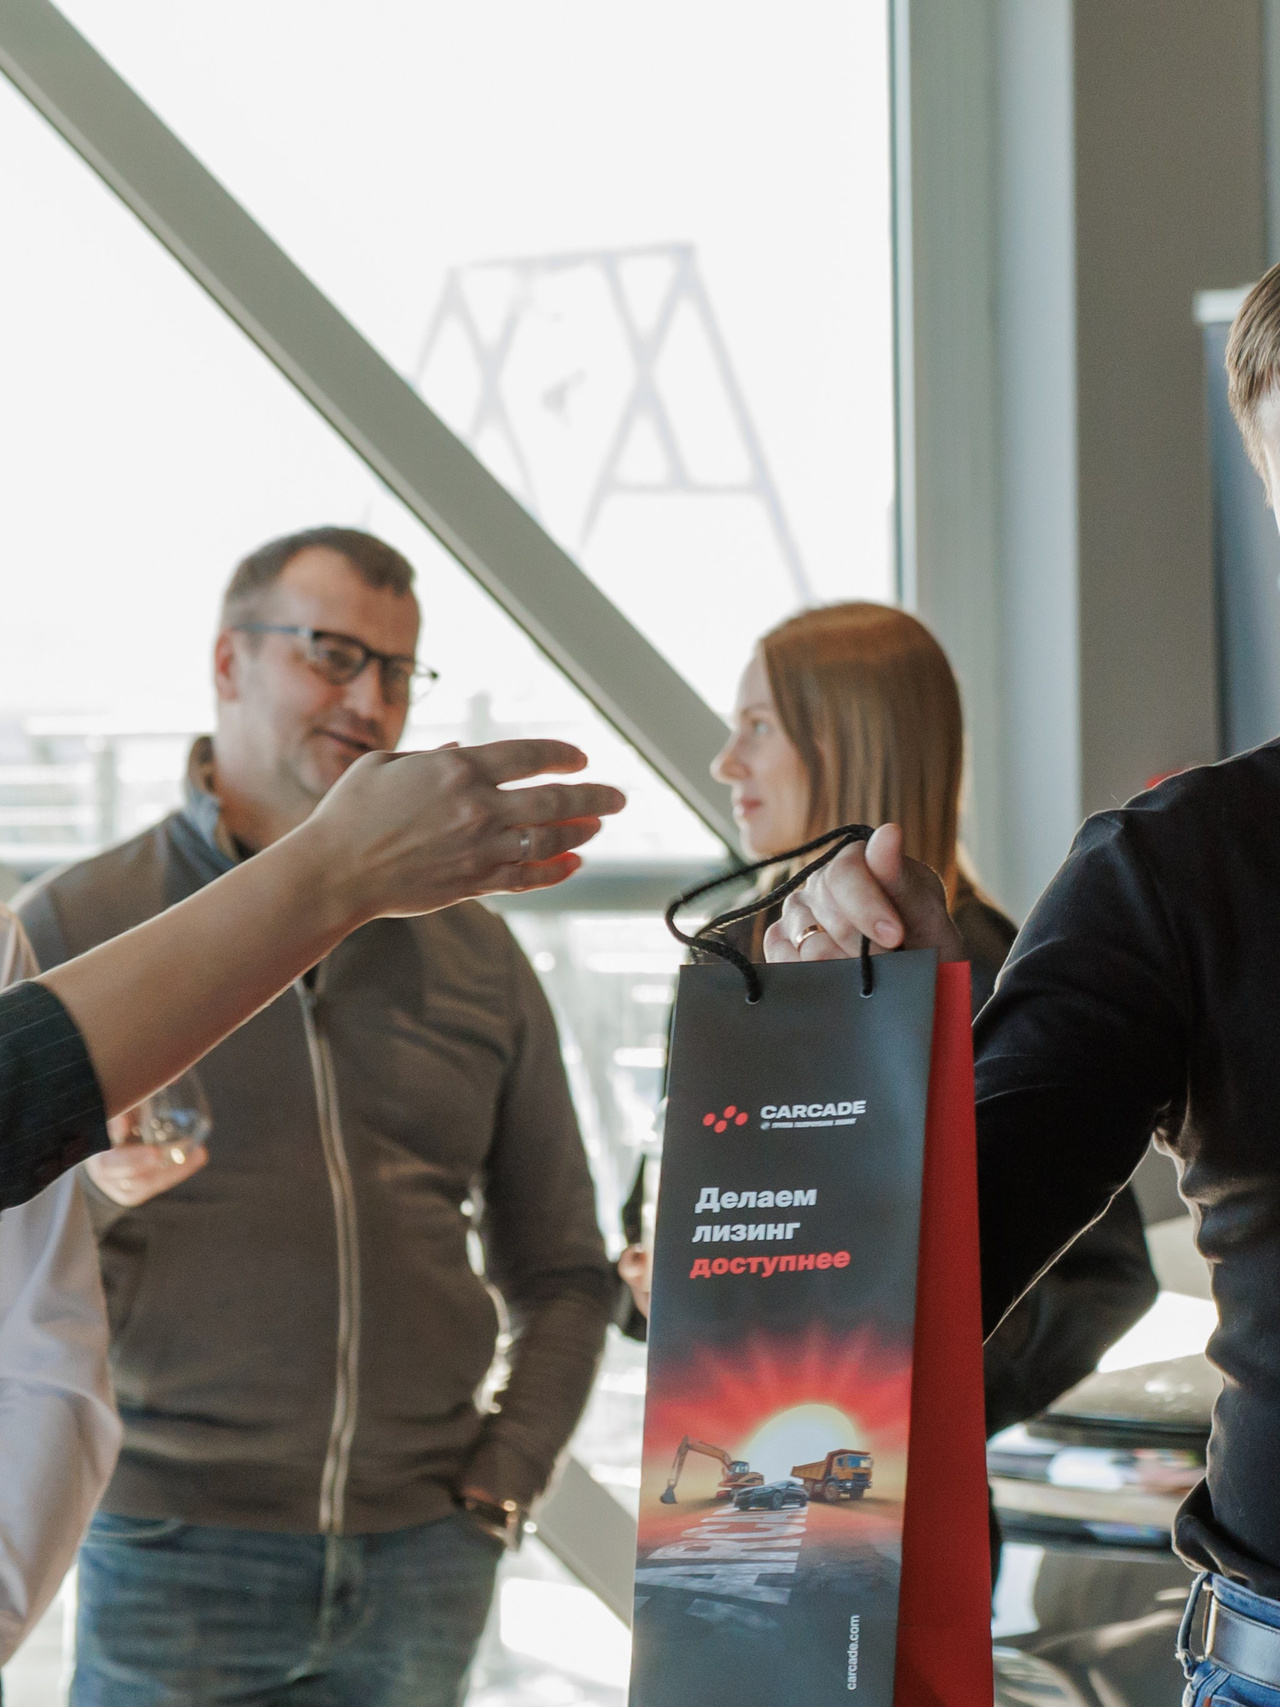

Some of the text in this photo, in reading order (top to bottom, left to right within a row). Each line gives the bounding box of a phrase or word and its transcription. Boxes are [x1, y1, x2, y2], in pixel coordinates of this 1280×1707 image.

[760, 1100, 866, 1119] CARCADE
[694, 1187, 817, 1213] Делаем
[691, 1222, 800, 1242] лизинг
[689, 1250, 851, 1278] доступнее
[847, 1614, 860, 1691] carcade.com
